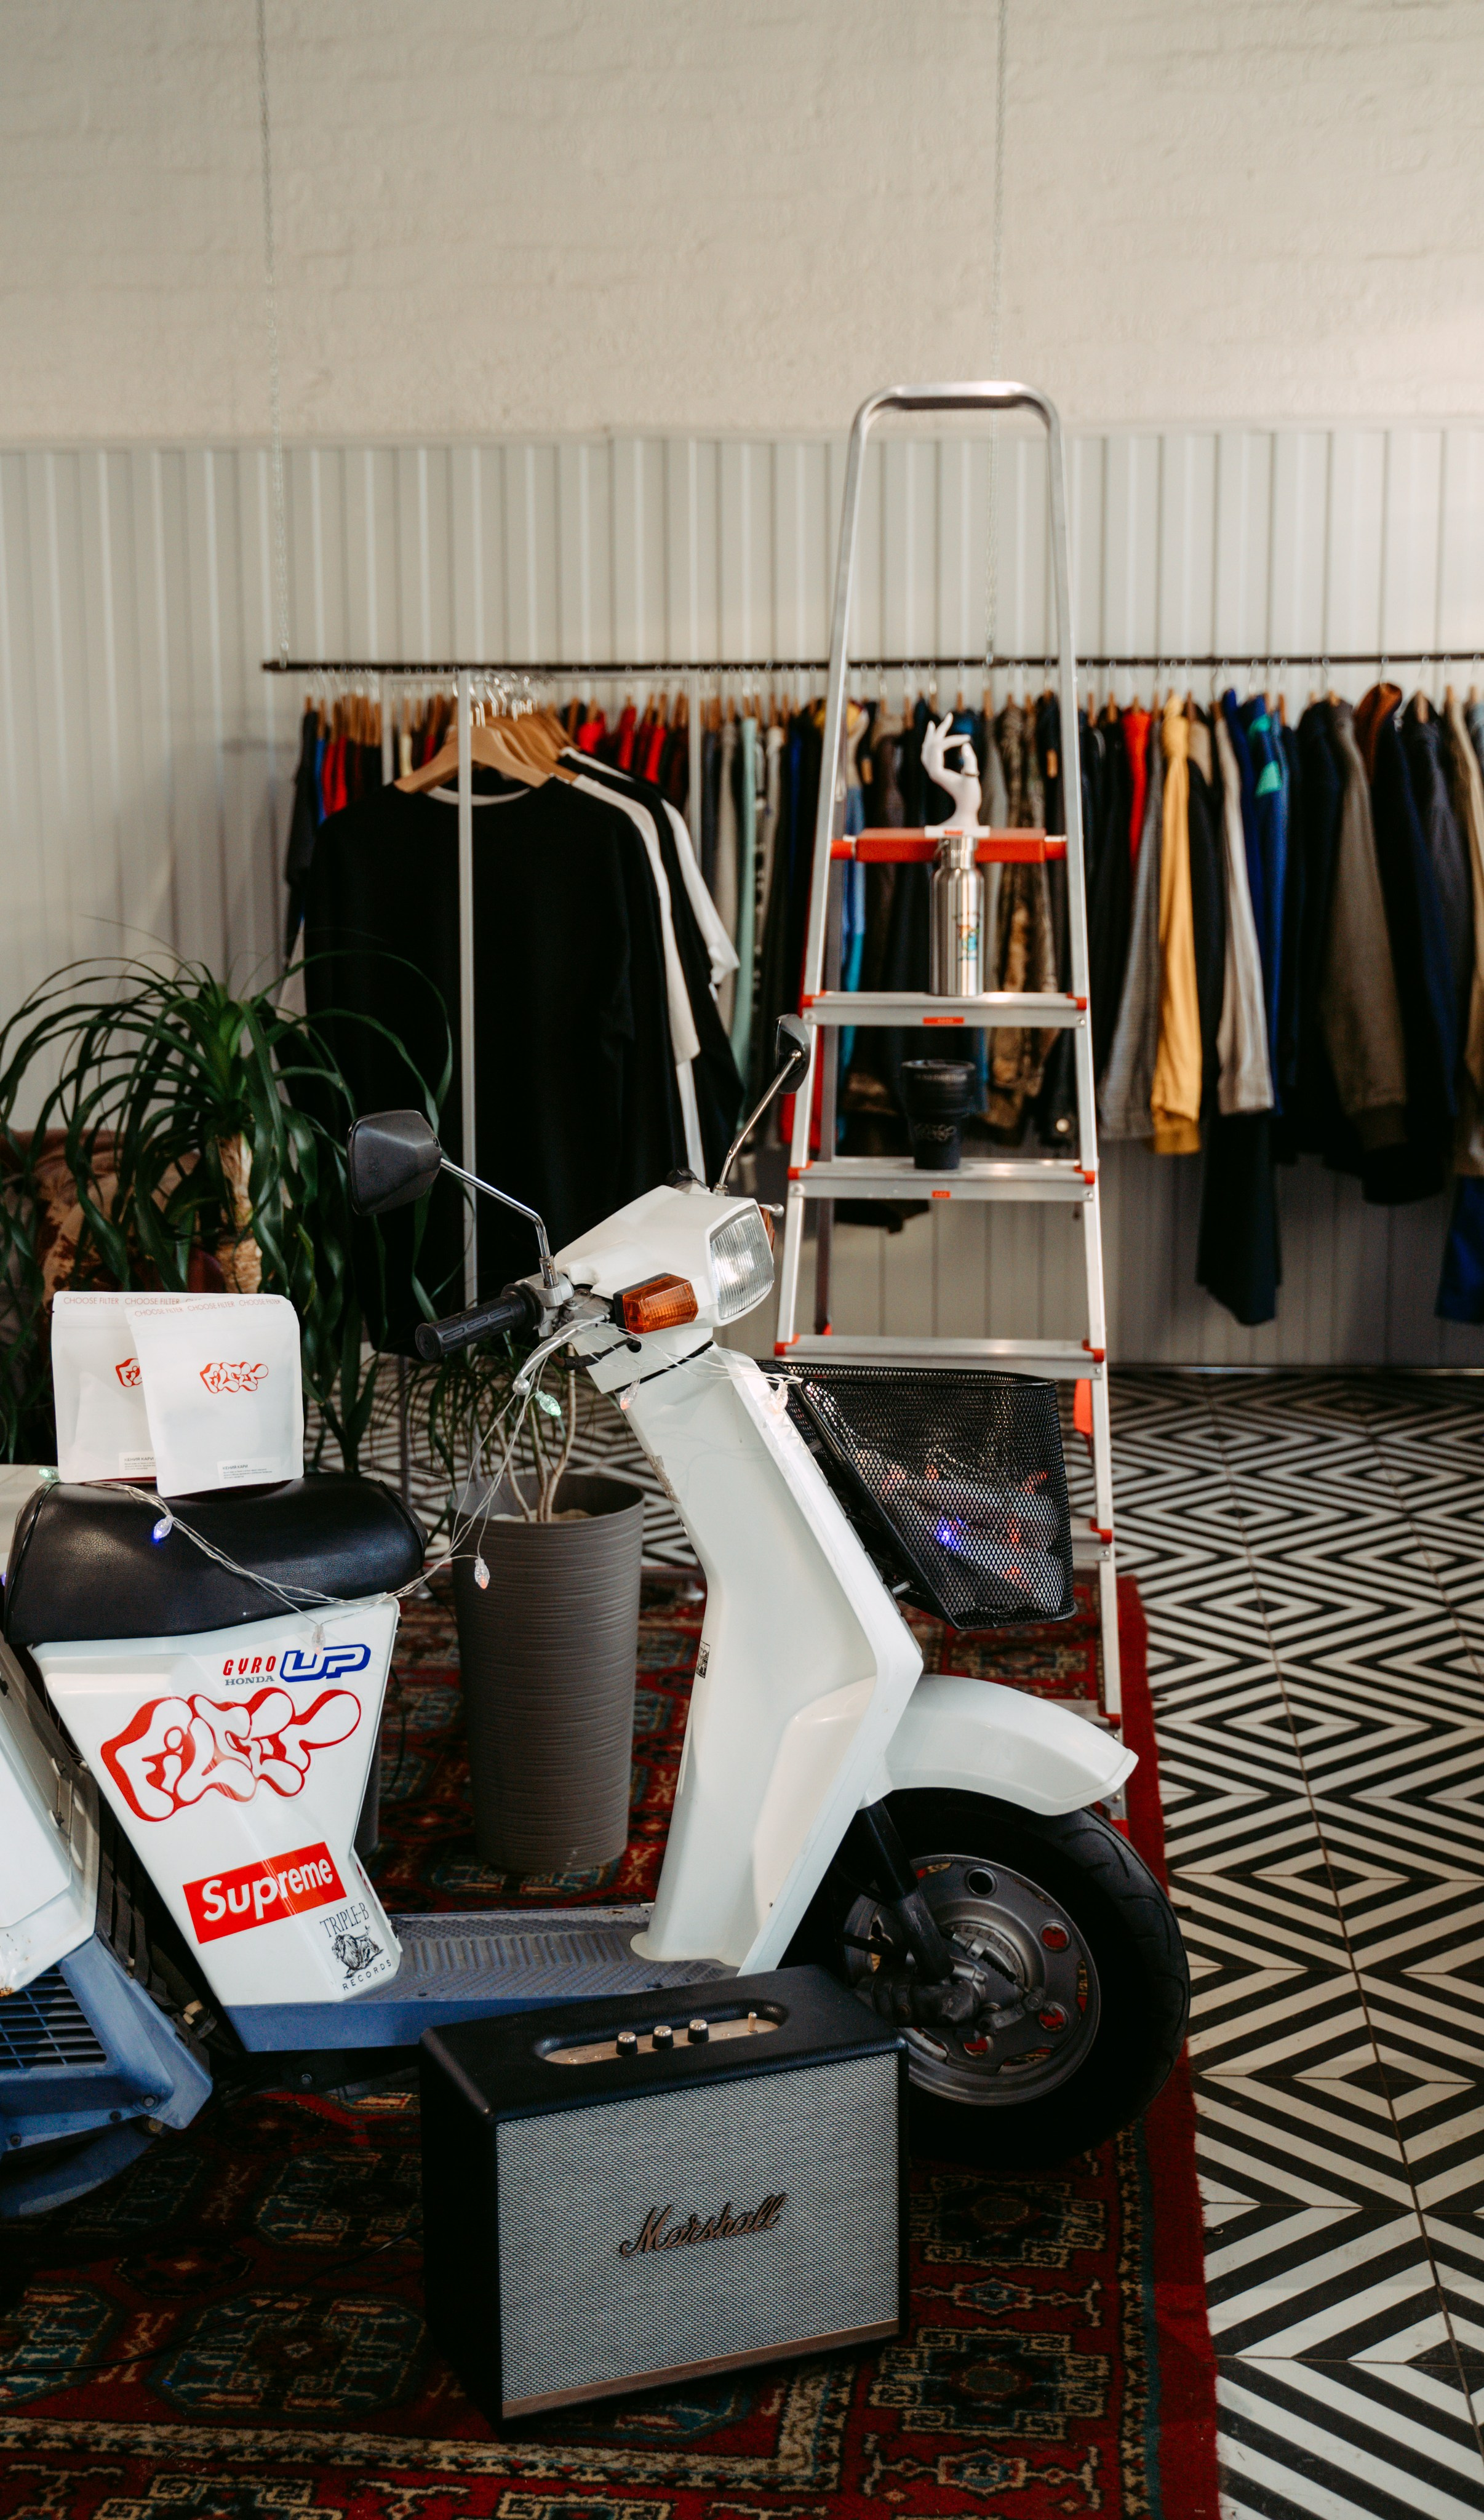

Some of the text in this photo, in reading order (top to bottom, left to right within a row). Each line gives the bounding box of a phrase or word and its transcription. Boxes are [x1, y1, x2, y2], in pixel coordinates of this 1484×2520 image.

[134, 1309, 166, 1317] CHOOSE
[187, 1303, 217, 1312] CHOOSE
[223, 1643, 371, 1683] GYRO UP
[225, 1675, 275, 1686] HONDA
[202, 1858, 333, 1921] Supreme
[319, 1902, 369, 1938] TRIPLE-B
[342, 1959, 392, 1991] RECORDS
[620, 2192, 788, 2257] Marshall
